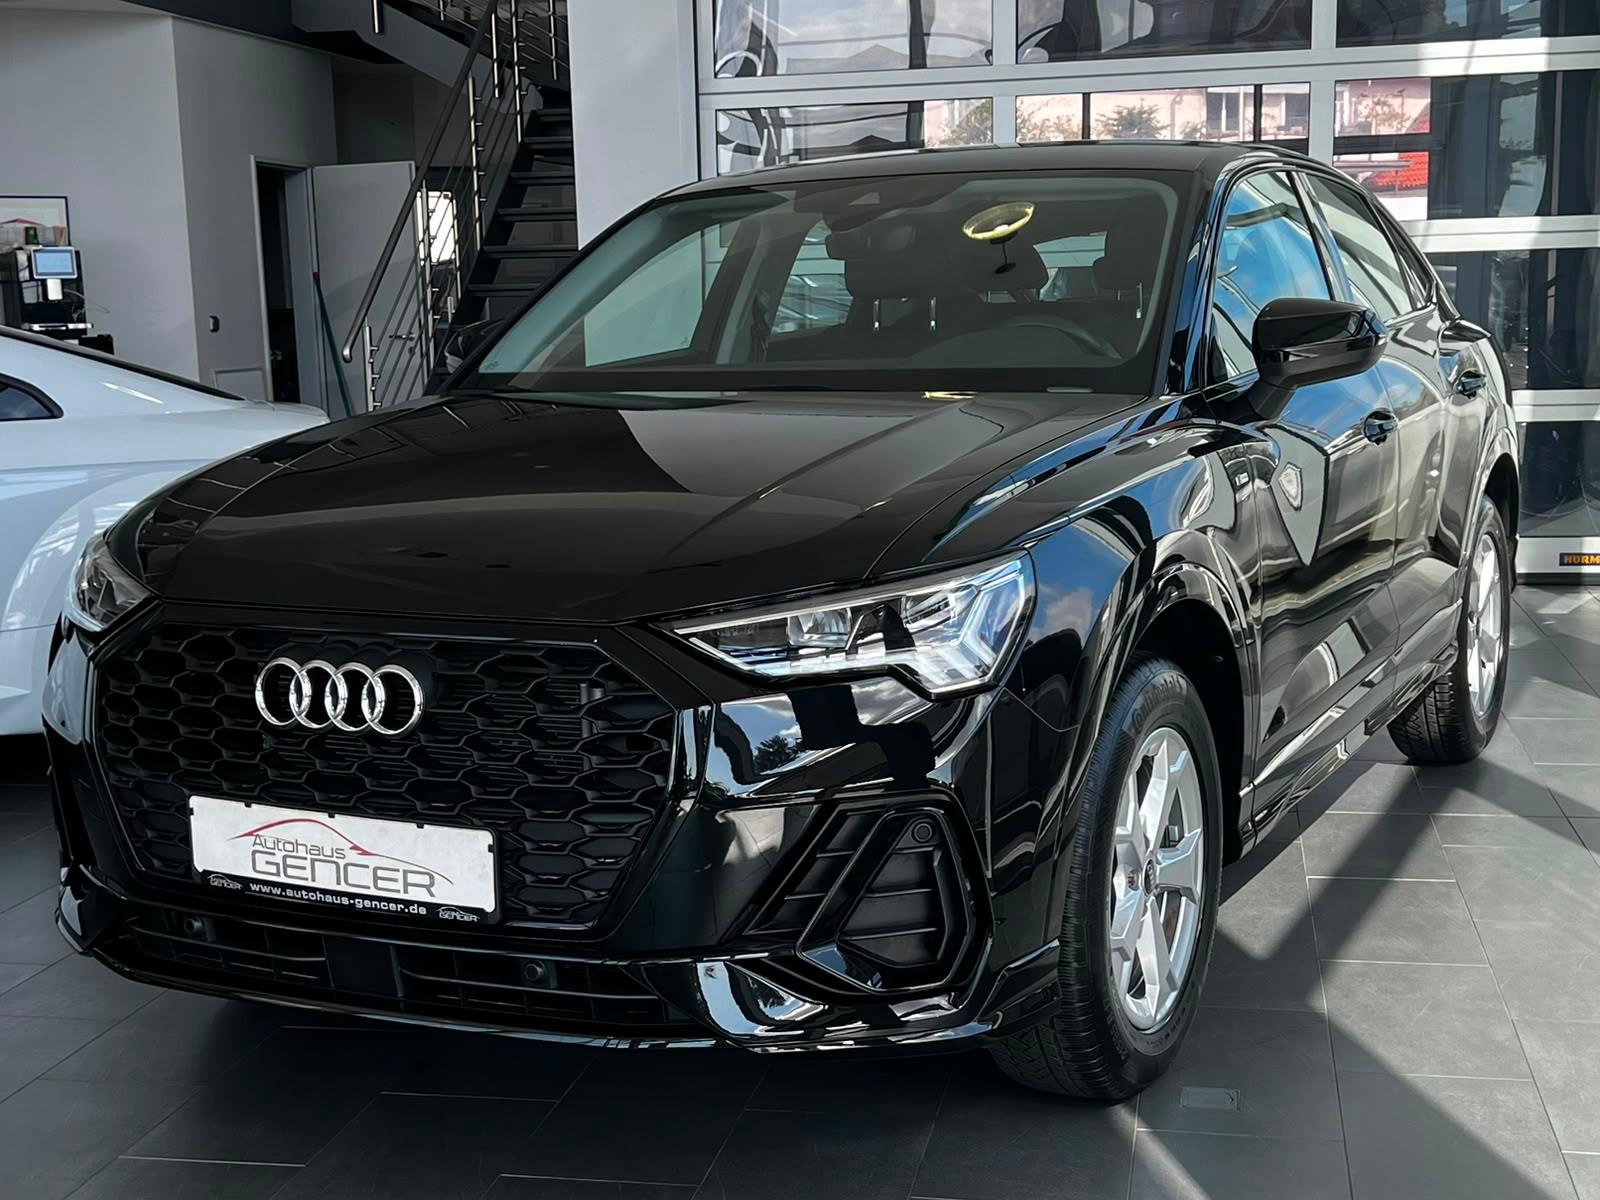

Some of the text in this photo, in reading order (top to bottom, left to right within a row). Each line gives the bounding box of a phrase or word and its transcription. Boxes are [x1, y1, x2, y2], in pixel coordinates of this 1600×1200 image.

[252, 833, 346, 859] Autohaus
[251, 849, 436, 897] GENCER
[249, 883, 427, 915] www.autohaus-gencer.de
